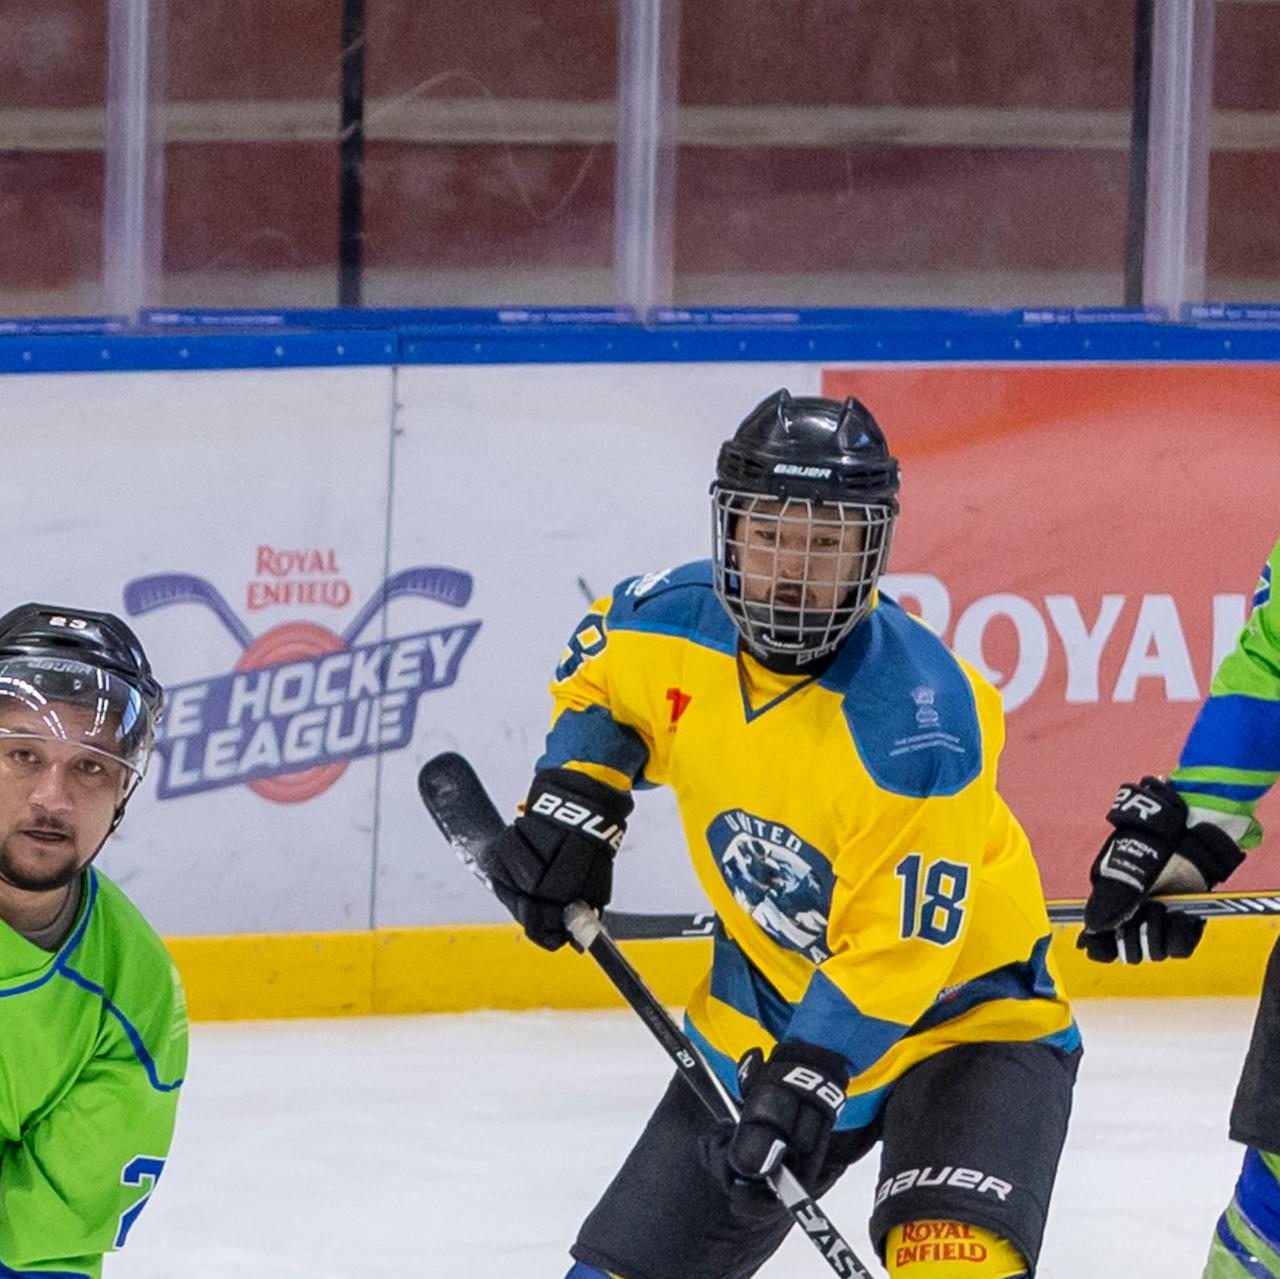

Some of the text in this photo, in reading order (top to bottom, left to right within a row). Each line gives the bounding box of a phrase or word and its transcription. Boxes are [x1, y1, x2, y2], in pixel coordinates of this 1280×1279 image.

[773, 463, 832, 479] BAUER
[256, 545, 339, 577] ROYAL
[247, 580, 351, 614] ENFIELD
[227, 628, 466, 726] HOCKEY
[168, 689, 408, 788] LEAGUE
[895, 853, 969, 948] 18
[875, 1166, 1014, 1206] BAUER
[901, 1221, 976, 1243] ROYAL
[896, 1243, 988, 1268] ENFIELD
